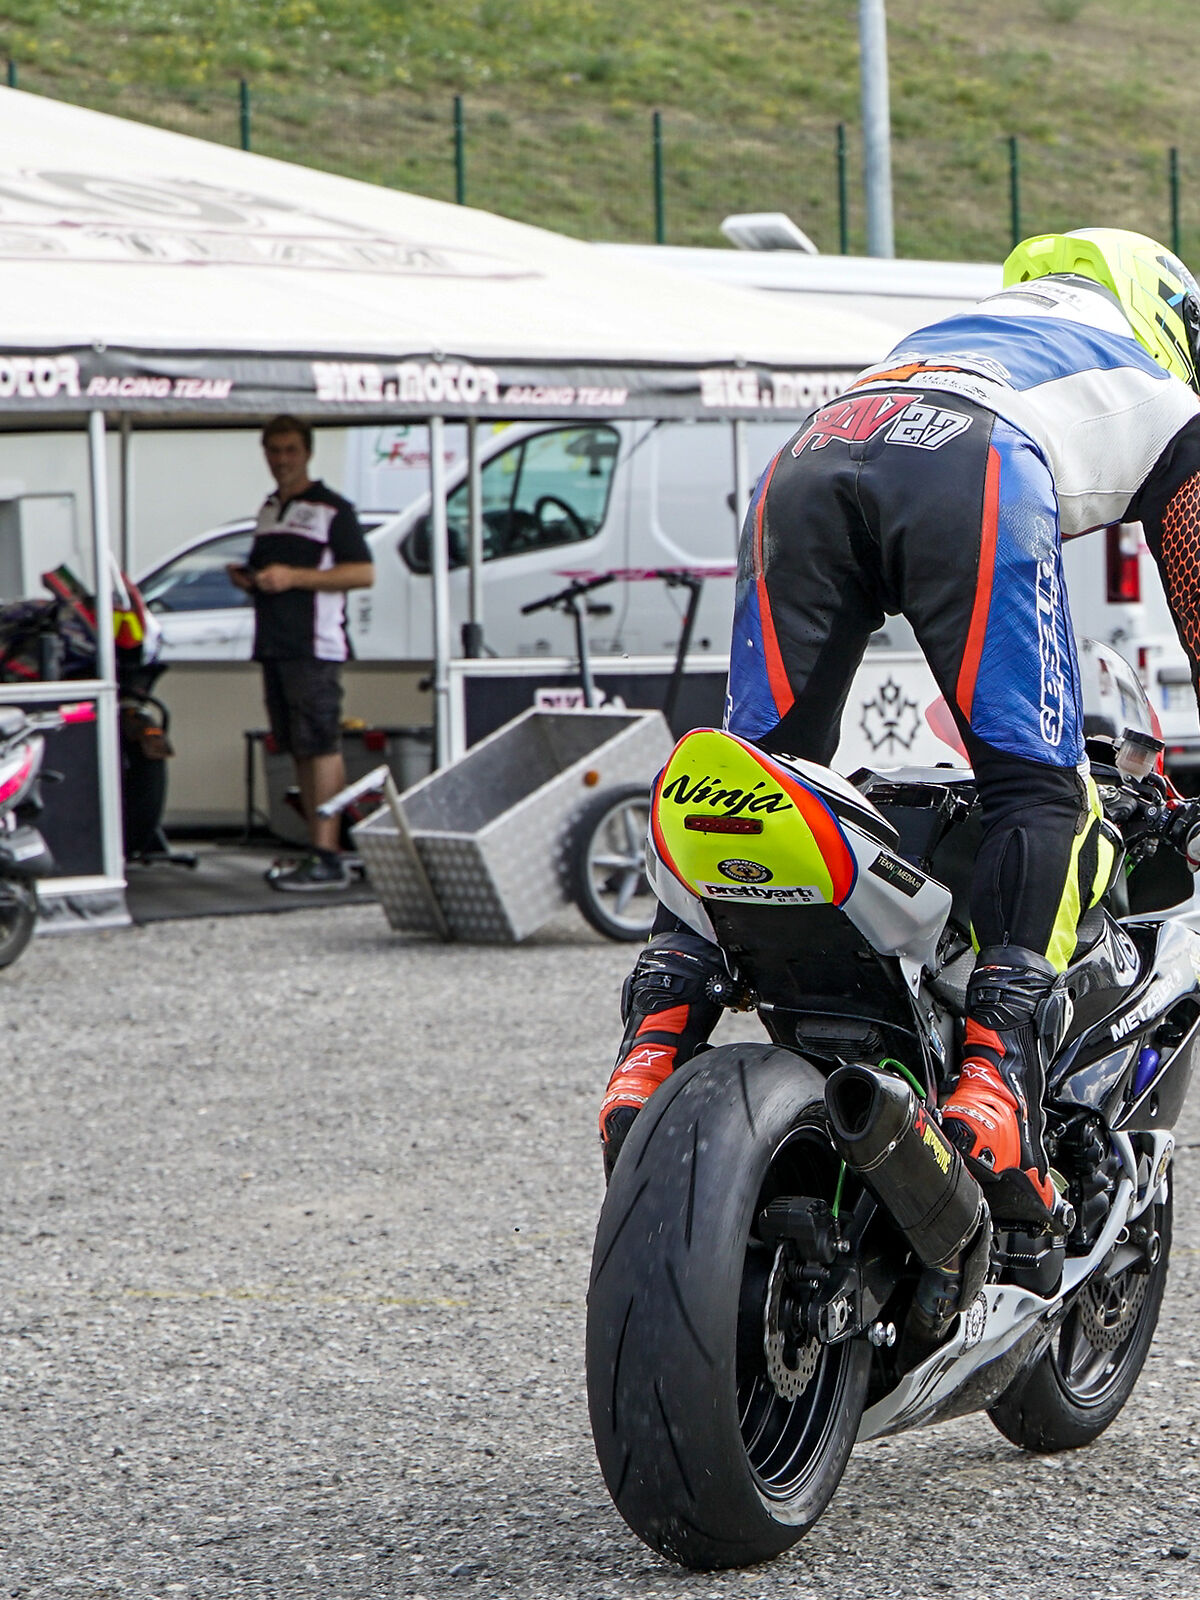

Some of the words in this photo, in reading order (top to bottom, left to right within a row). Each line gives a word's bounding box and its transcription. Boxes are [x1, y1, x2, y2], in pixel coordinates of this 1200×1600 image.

[87, 376, 171, 399] RACING
[173, 378, 233, 400] TEAM
[396, 362, 499, 404] MOTOR
[503, 386, 574, 406] RACING
[577, 386, 628, 406] TEAM
[884, 403, 974, 451] 27
[662, 774, 794, 817] Ninja
[704, 884, 809, 900] prettyart
